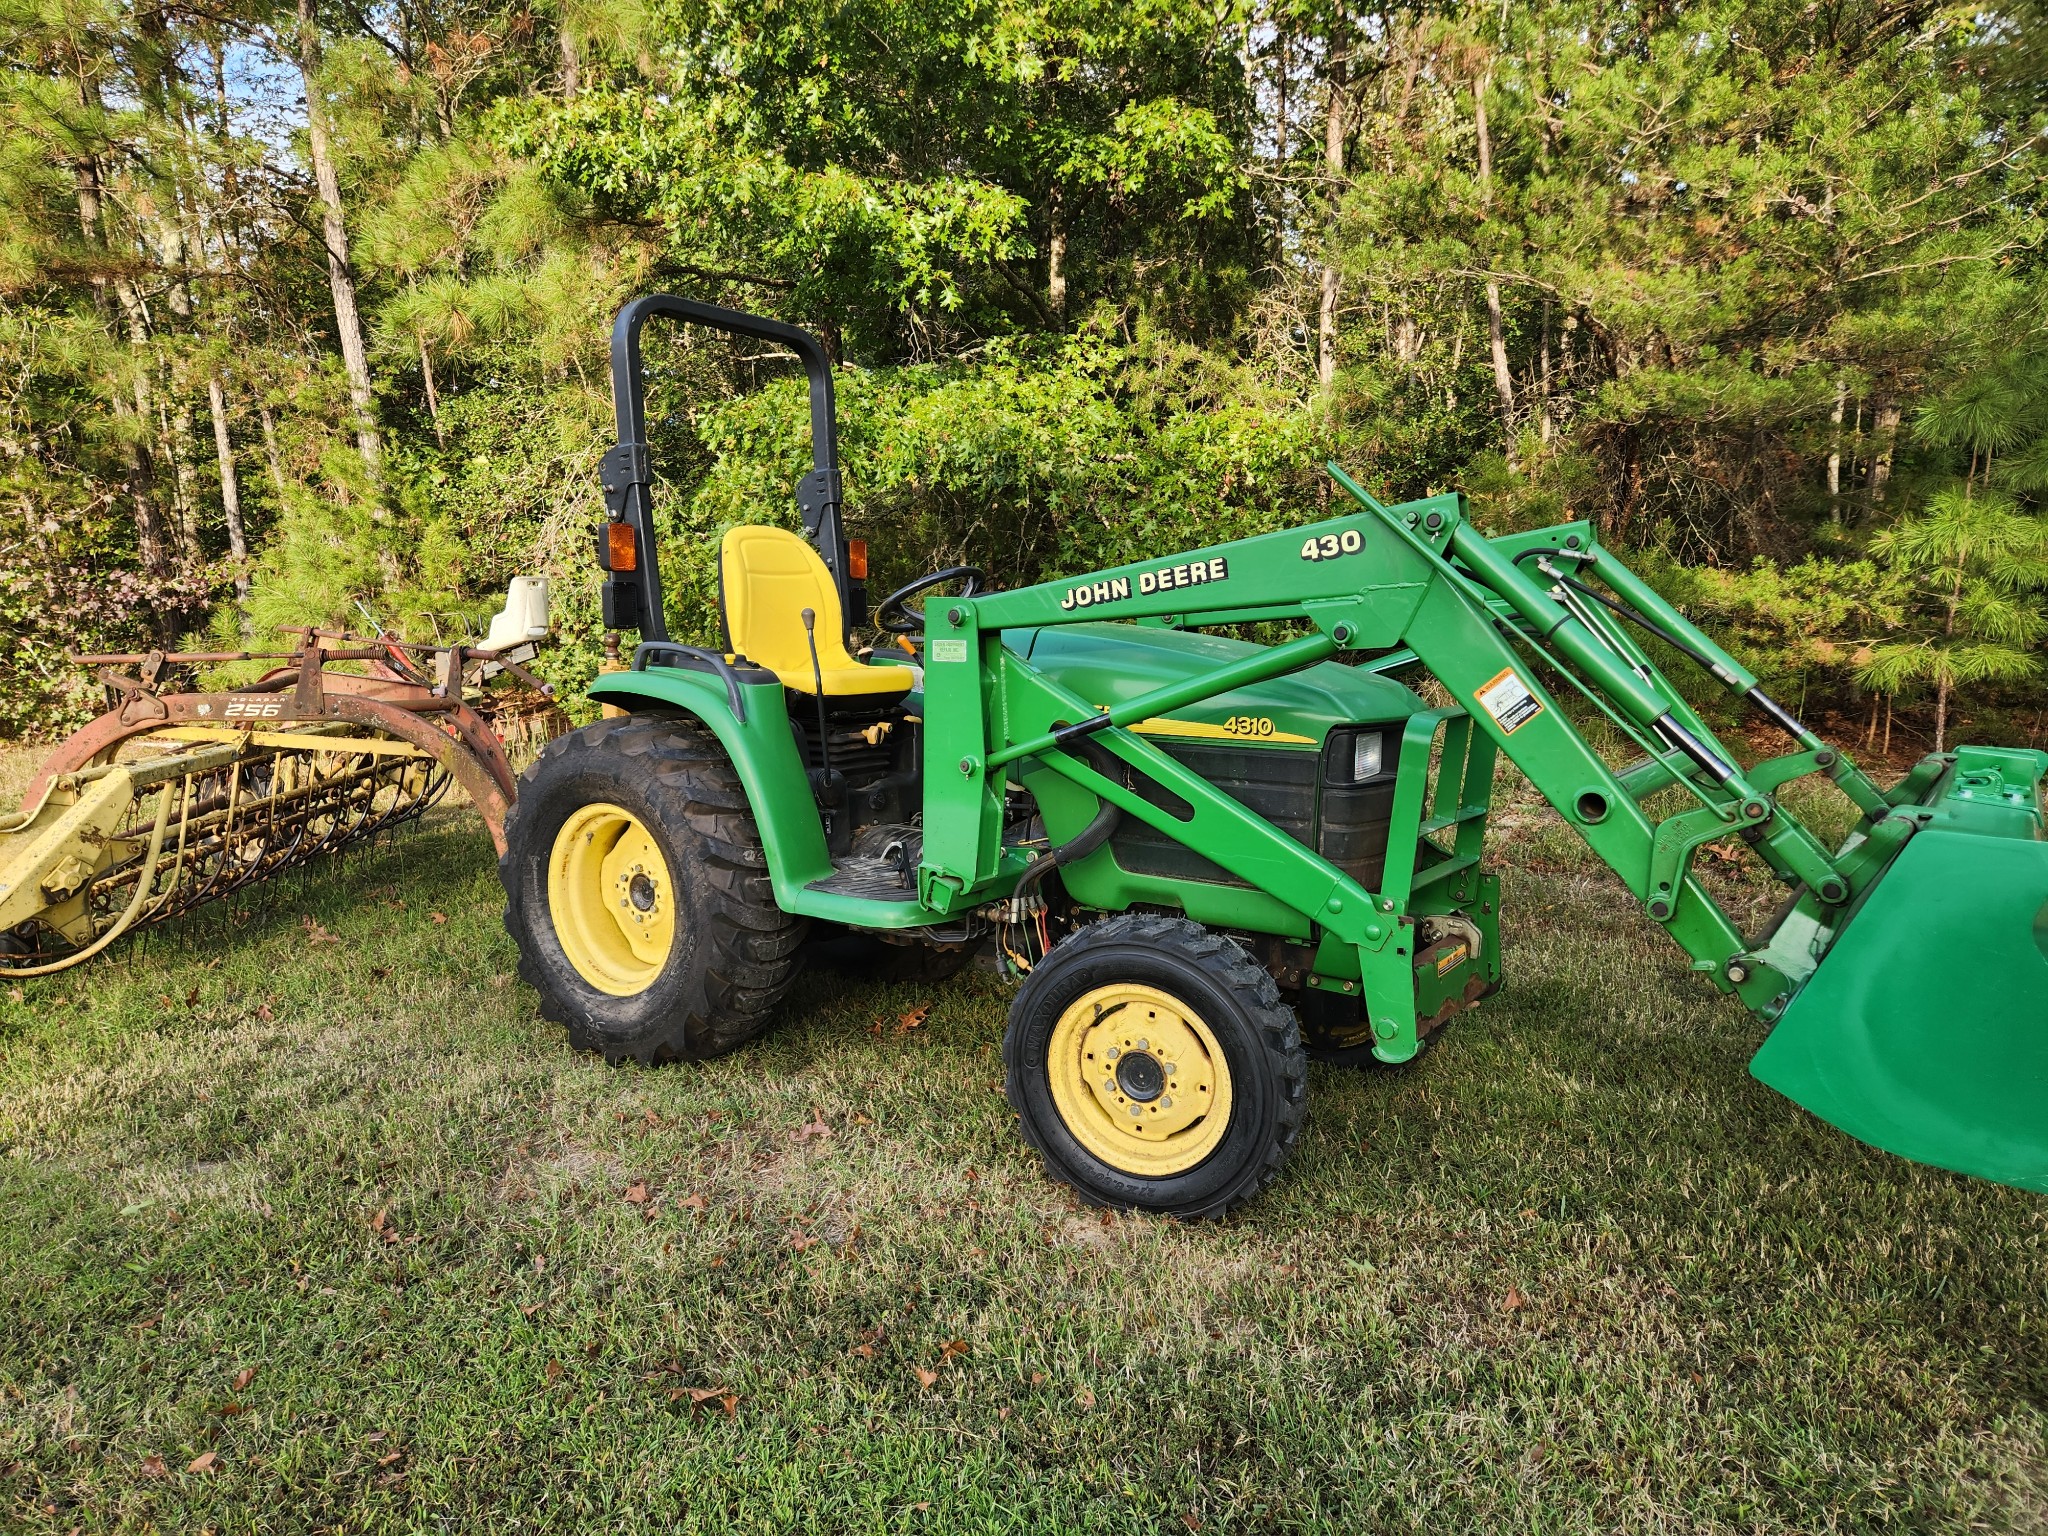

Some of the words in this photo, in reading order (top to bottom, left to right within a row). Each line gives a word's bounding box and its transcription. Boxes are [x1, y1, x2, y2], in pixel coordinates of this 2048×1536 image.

[1301, 530, 1366, 562] 430
[1061, 577, 1132, 611] JOHN
[1138, 557, 1229, 595] DEERE
[1485, 671, 1510, 690] WARNING
[224, 703, 282, 717] 256
[1223, 716, 1276, 737] 4310
